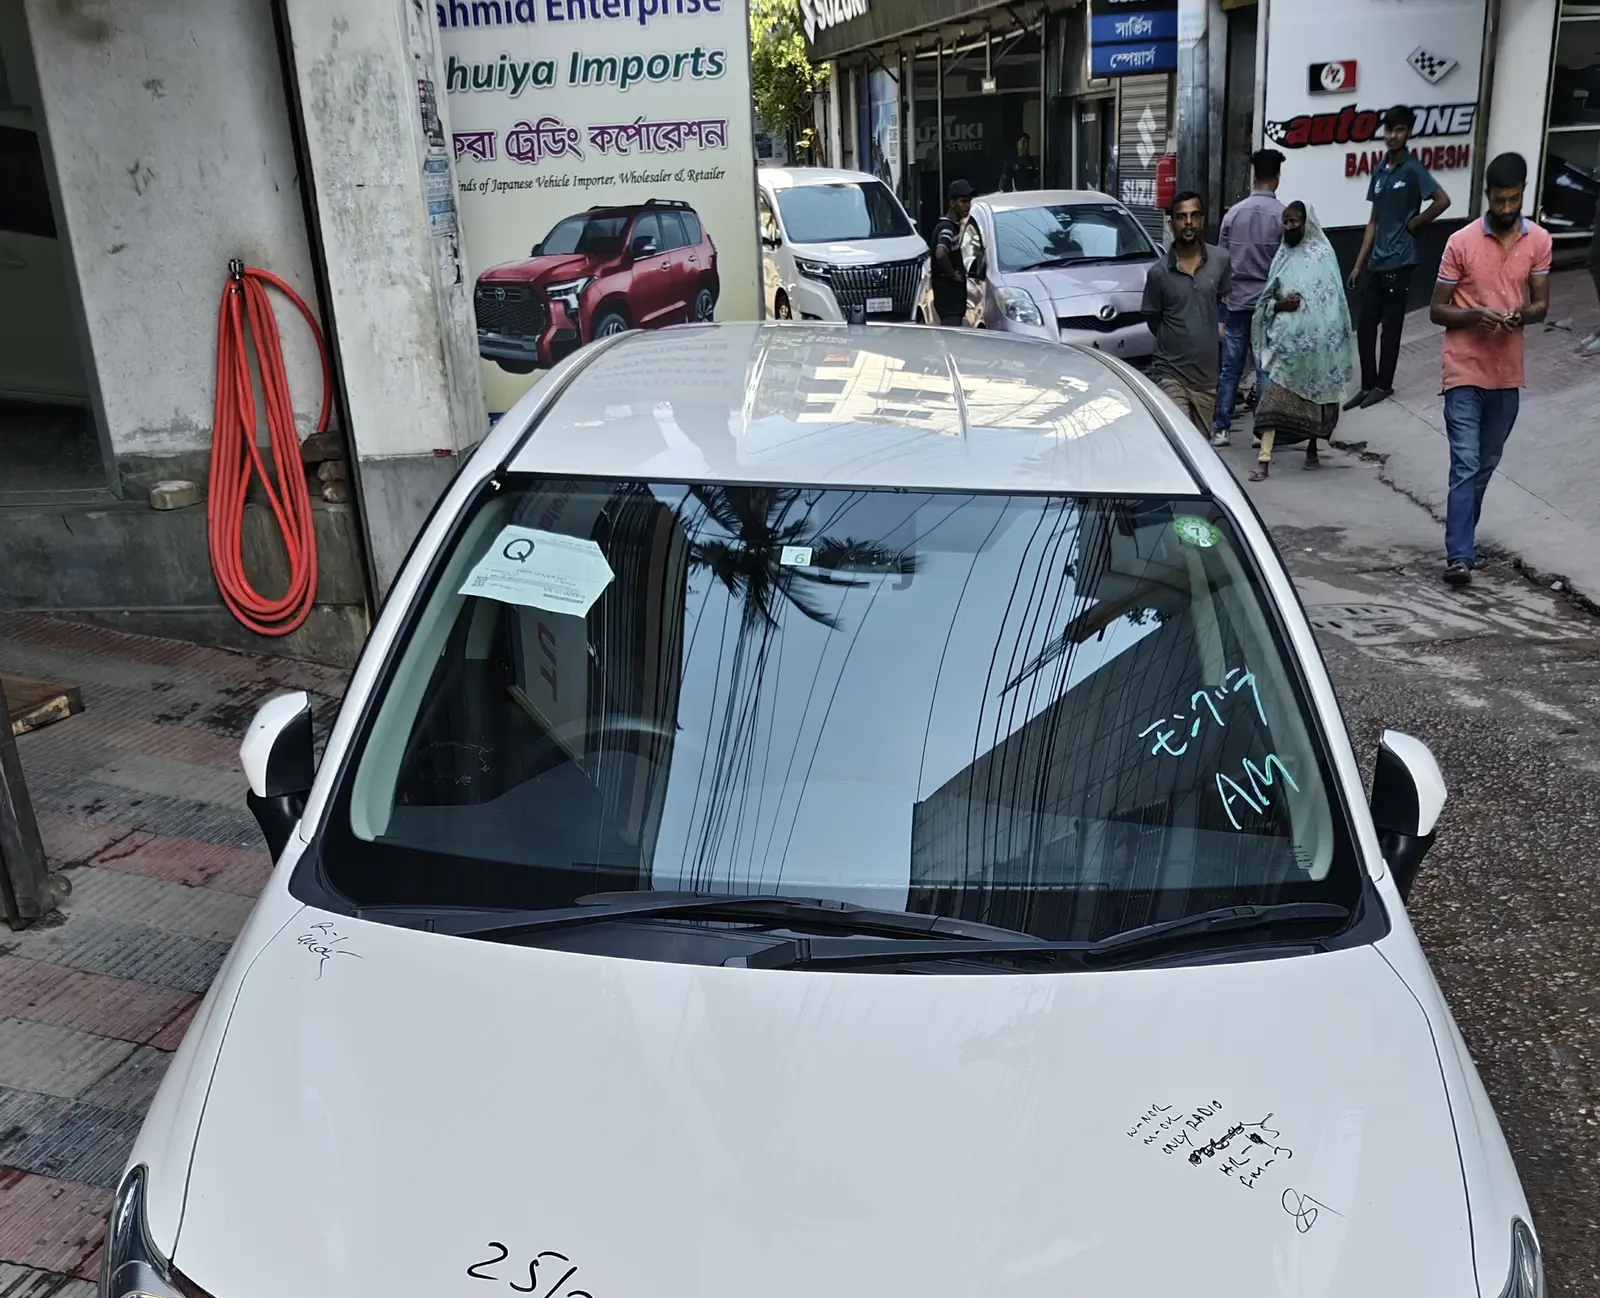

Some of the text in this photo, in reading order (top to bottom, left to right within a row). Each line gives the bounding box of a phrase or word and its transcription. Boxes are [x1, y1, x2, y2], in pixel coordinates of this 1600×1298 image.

[569, 47, 725, 90] Imports
[505, 117, 584, 162] ট্রেডিং
[587, 116, 727, 153] কর্পোরেশন
[903, 122, 984, 142] UZUKI
[1345, 144, 1470, 177] BANDESH
[479, 178, 491, 195] of
[491, 179, 534, 194] Japanese
[535, 174, 570, 188] Vehicle
[573, 173, 616, 191] Importer,
[619, 168, 672, 184] Wholesaler
[674, 169, 685, 182] &
[686, 167, 727, 183] Retailer
[502, 538, 535, 564] Q
[1215, 753, 1299, 830] AM
[1185, 1100, 1224, 1131] RADIO
